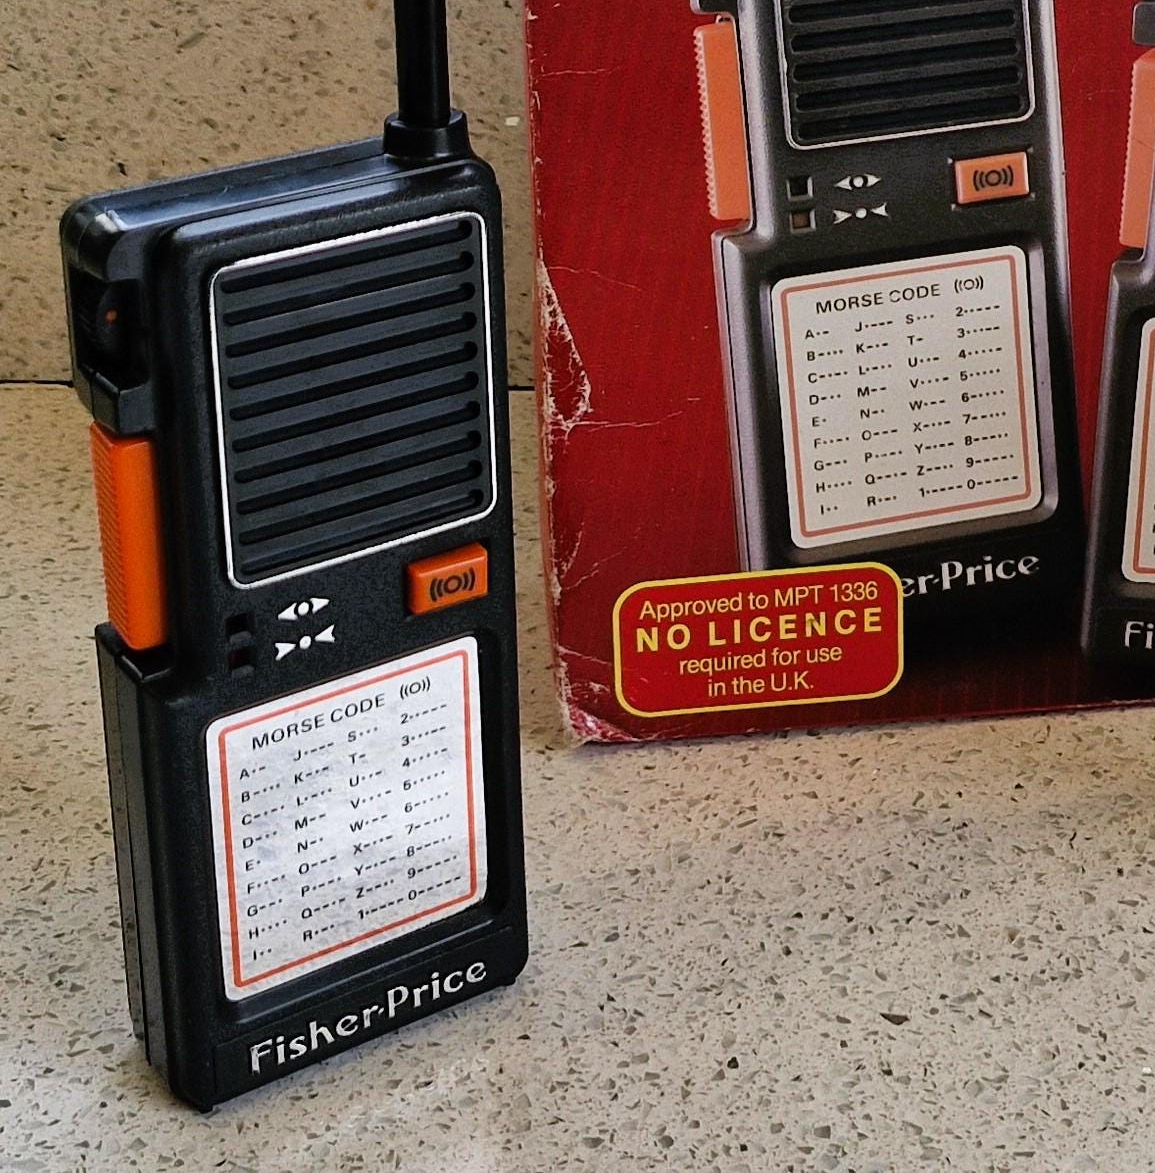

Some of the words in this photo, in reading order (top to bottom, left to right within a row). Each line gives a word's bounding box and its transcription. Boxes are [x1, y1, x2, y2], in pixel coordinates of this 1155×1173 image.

[815, 292, 884, 315] MORSE
[889, 283, 941, 303] CODE
[639, 592, 742, 623] Approved
[747, 592, 768, 612] to
[774, 585, 823, 607] MPT
[829, 581, 878, 603] 1336
[635, 623, 692, 652] NO
[708, 608, 882, 647] LICENCE
[679, 647, 766, 676] required
[771, 646, 801, 666] for
[806, 644, 842, 664] use
[708, 678, 727, 697] in
[731, 676, 765, 695] the
[771, 670, 814, 691] U.K.
[251, 712, 325, 751] MORSE
[330, 692, 386, 724] CODE
[249, 959, 488, 1075] Fisher-Price
